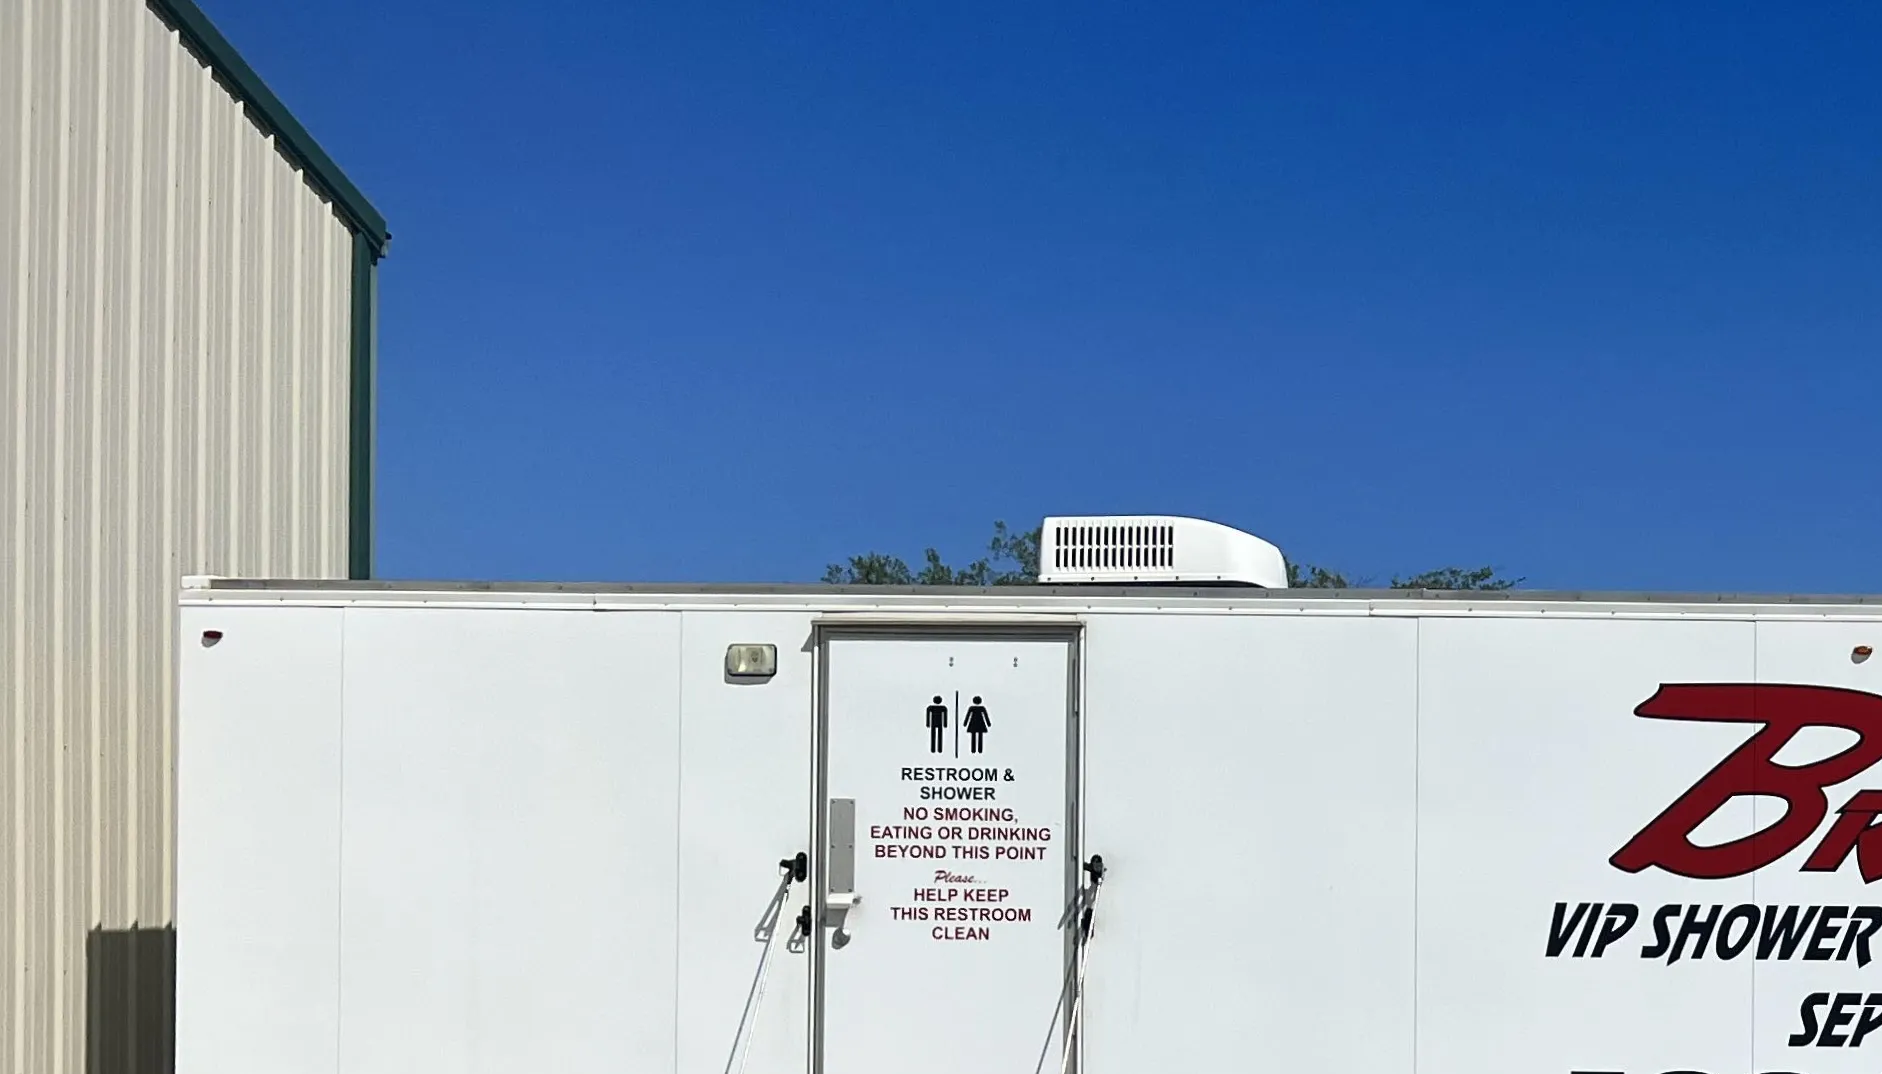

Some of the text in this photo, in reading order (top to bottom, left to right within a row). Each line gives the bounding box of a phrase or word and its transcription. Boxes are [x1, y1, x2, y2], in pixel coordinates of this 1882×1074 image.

[901, 768, 1015, 781] RESTROOM &
[920, 787, 995, 800] SHOWER
[903, 807, 1018, 824] NO SMOKING,
[870, 826, 1051, 841] EATING OR DRINKING
[875, 845, 1047, 860] BEYOND THIS POINT
[914, 888, 1009, 902] HELP KEEP
[890, 908, 1031, 921] THIS RESTROOM
[932, 927, 990, 940] CLEAN
[1546, 903, 1638, 957] VIP
